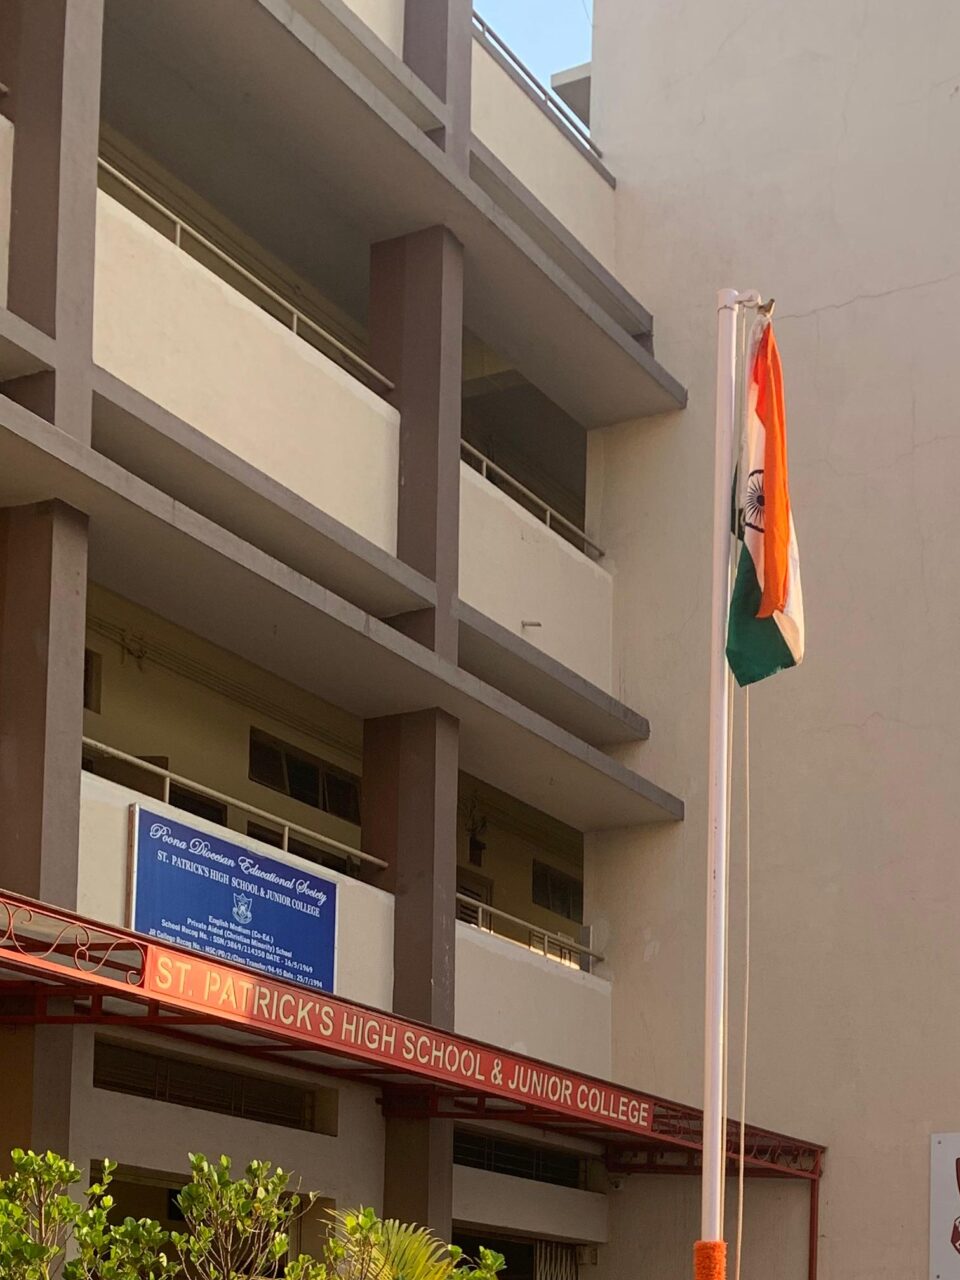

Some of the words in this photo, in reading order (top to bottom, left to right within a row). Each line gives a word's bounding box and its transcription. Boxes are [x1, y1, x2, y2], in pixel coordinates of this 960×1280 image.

[150, 823, 187, 850] Poona
[189, 838, 236, 868] Diocesan
[238, 856, 295, 890] Educational
[295, 879, 327, 906] Society
[157, 850, 169, 863] ST.
[171, 855, 209, 878] PATRICK'S
[210, 870, 229, 885] HIGH
[231, 876, 259, 896] SCHOOL
[260, 888, 265, 898] &
[265, 889, 291, 908] JUNIOR
[292, 899, 320, 918] COLLEGE
[161, 918, 181, 932] School
[265, 951, 281, 964] DATE
[187, 917, 207, 931] Private
[207, 923, 223, 936] Aided
[224, 927, 250, 944] (Christian
[250, 938, 275, 954] Minority)
[275, 946, 293, 958] School
[208, 915, 229, 929] English
[229, 920, 251, 934] Medium
[155, 956, 193, 996] ST.
[204, 970, 335, 1037] PATRICK'S
[341, 1012, 397, 1054] HIGH
[402, 1031, 485, 1082] SCHOOL
[490, 1058, 503, 1086] &
[508, 1065, 573, 1105] JUNIOR
[576, 1084, 650, 1128] COLLEGE
